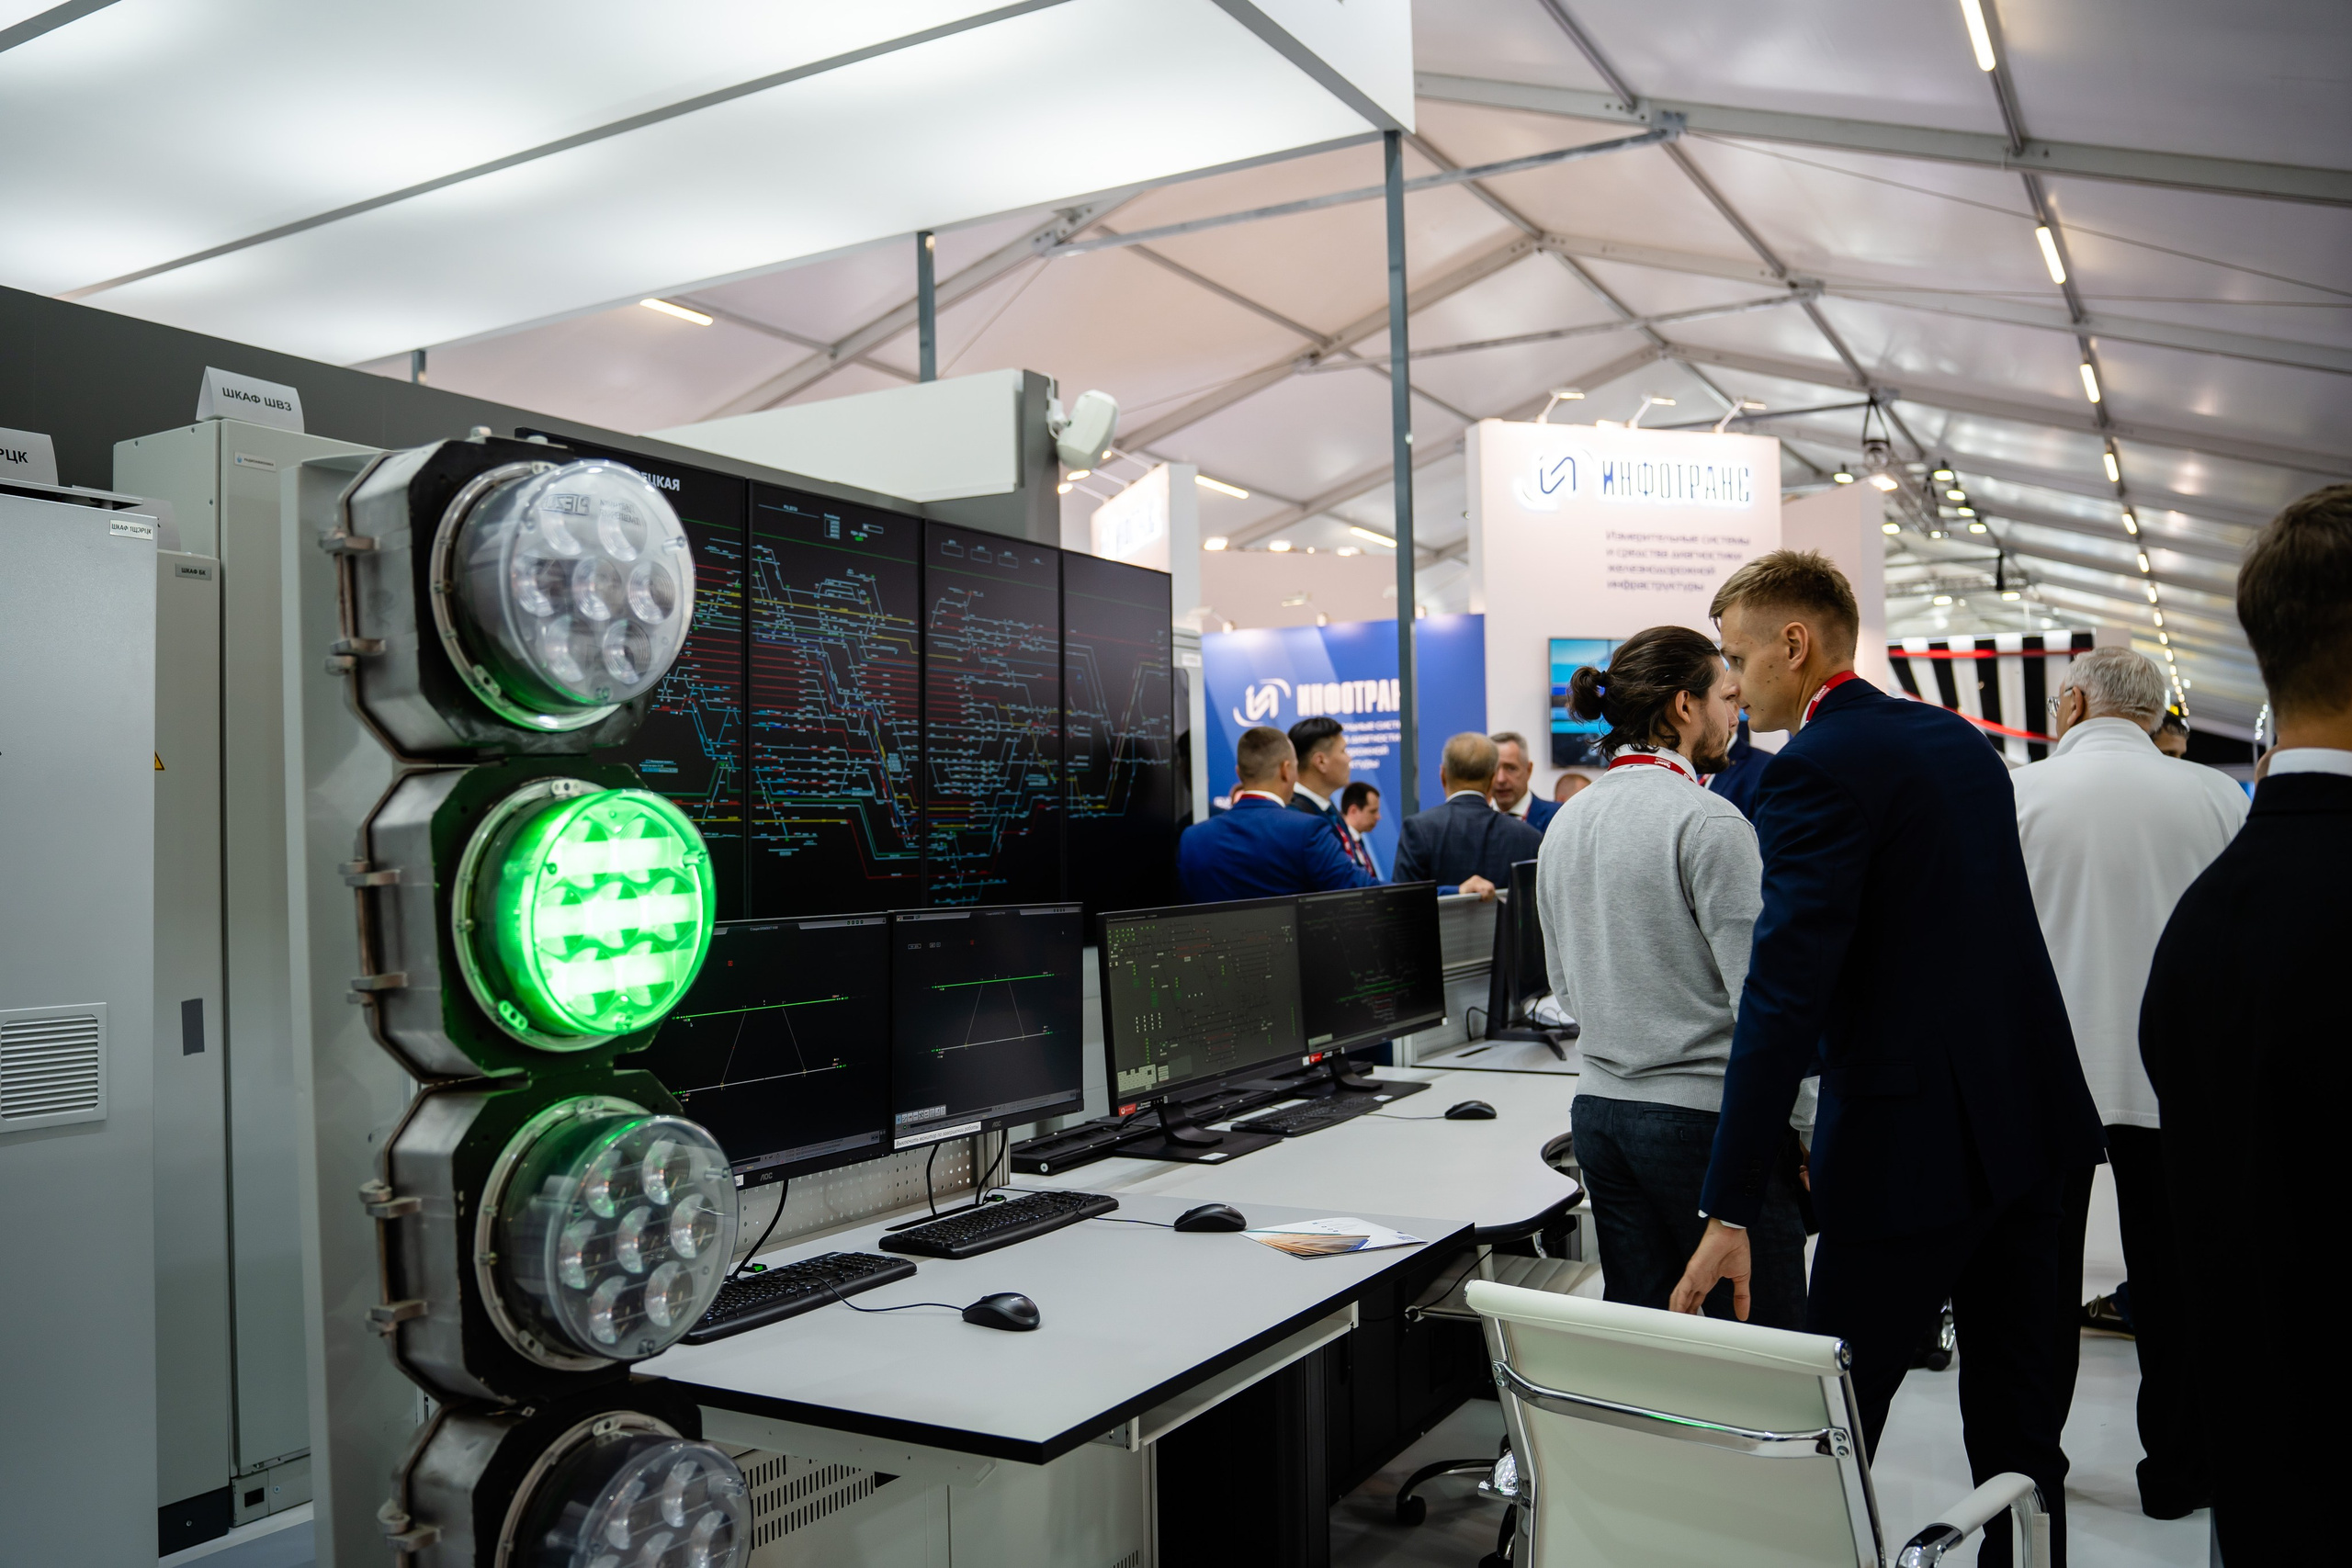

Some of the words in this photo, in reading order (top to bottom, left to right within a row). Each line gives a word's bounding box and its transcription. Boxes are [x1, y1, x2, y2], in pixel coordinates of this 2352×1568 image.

[222, 387, 261, 404] ШКАФ
[636, 470, 681, 491] ЕЦКАЯ
[1602, 460, 1750, 502] ИНФОТРАНС
[1296, 679, 1400, 716] ИНФОТРАН
[760, 1171, 773, 1182] AOC
